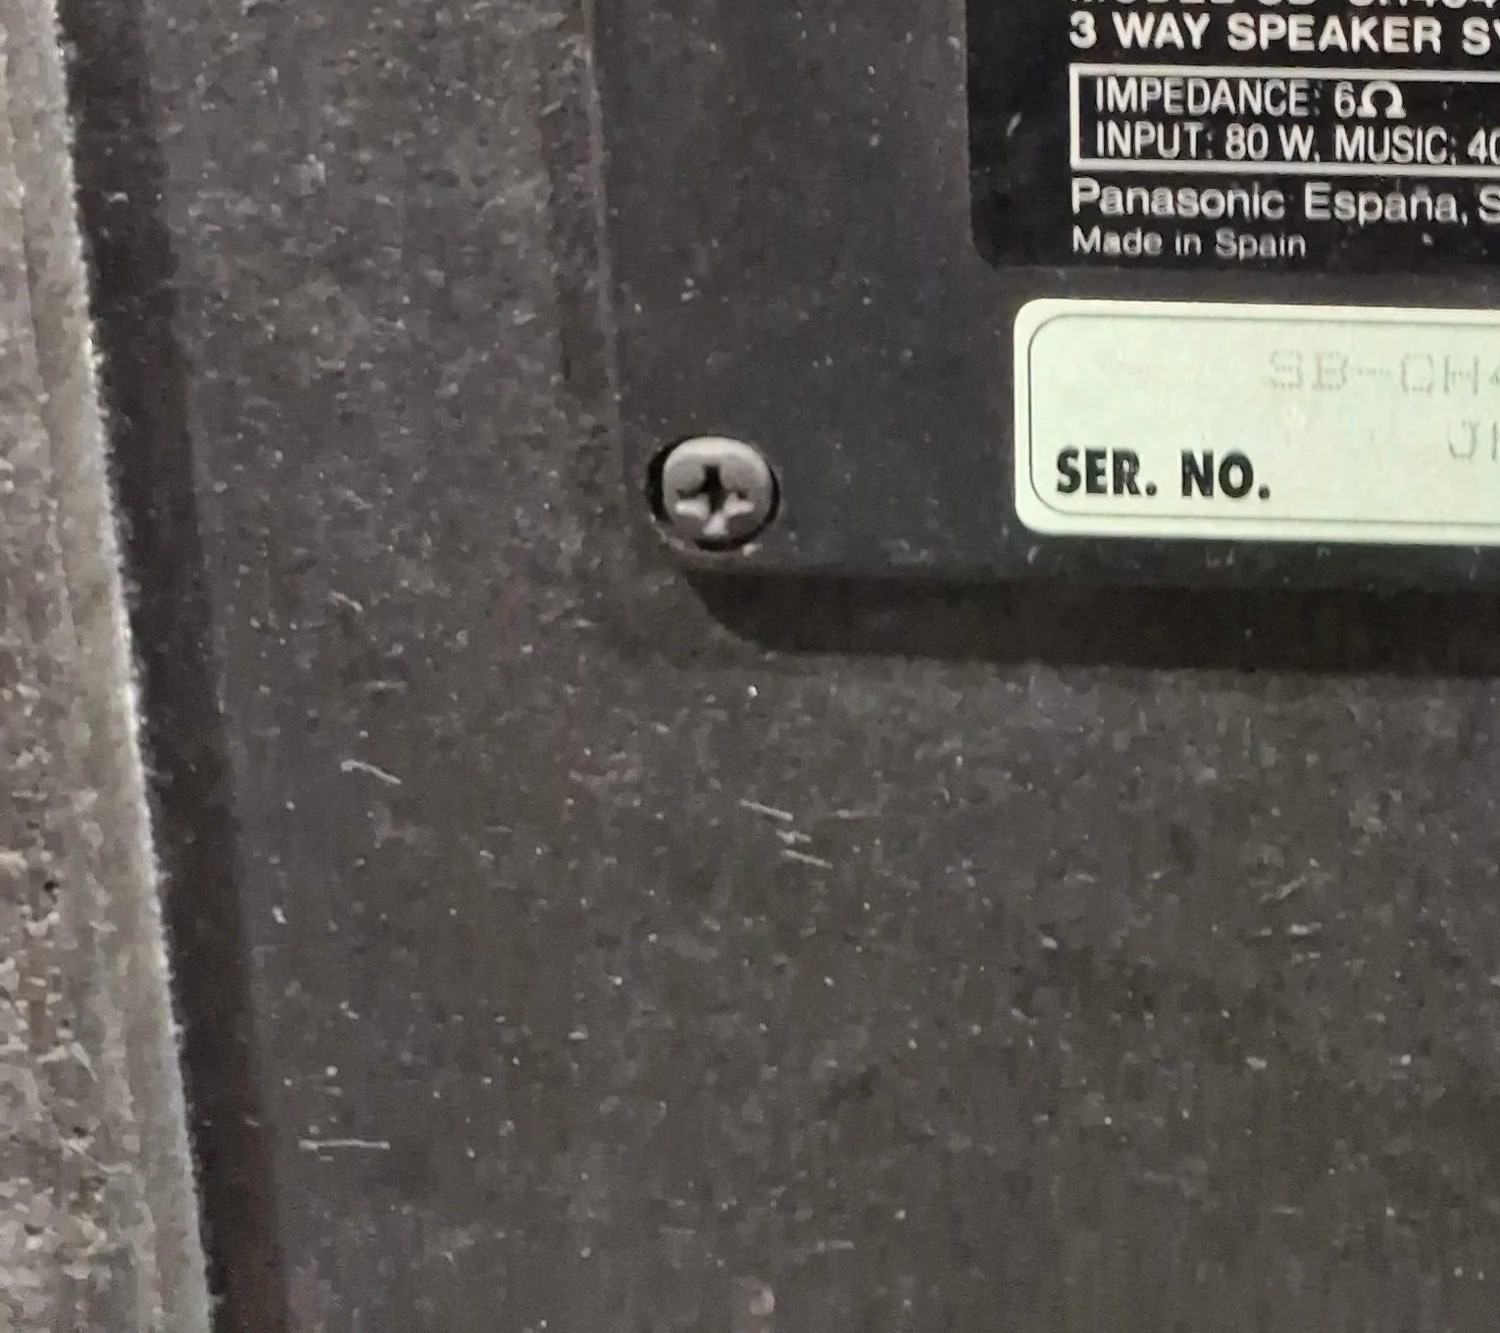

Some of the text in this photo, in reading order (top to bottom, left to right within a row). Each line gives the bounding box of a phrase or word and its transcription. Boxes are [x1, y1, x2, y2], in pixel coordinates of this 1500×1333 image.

[1069, 10, 1097, 49] 3
[1111, 11, 1211, 49] WAY
[1226, 12, 1442, 55] SPEAKER
[1096, 76, 1321, 117] IMPEDANCE:
[1096, 119, 1213, 159] INPUT:
[1225, 121, 1270, 161] 80
[1071, 176, 1286, 219] Panasonic
[1072, 224, 1306, 261] Made in Spain
[1056, 446, 1271, 501] SER. NO.
